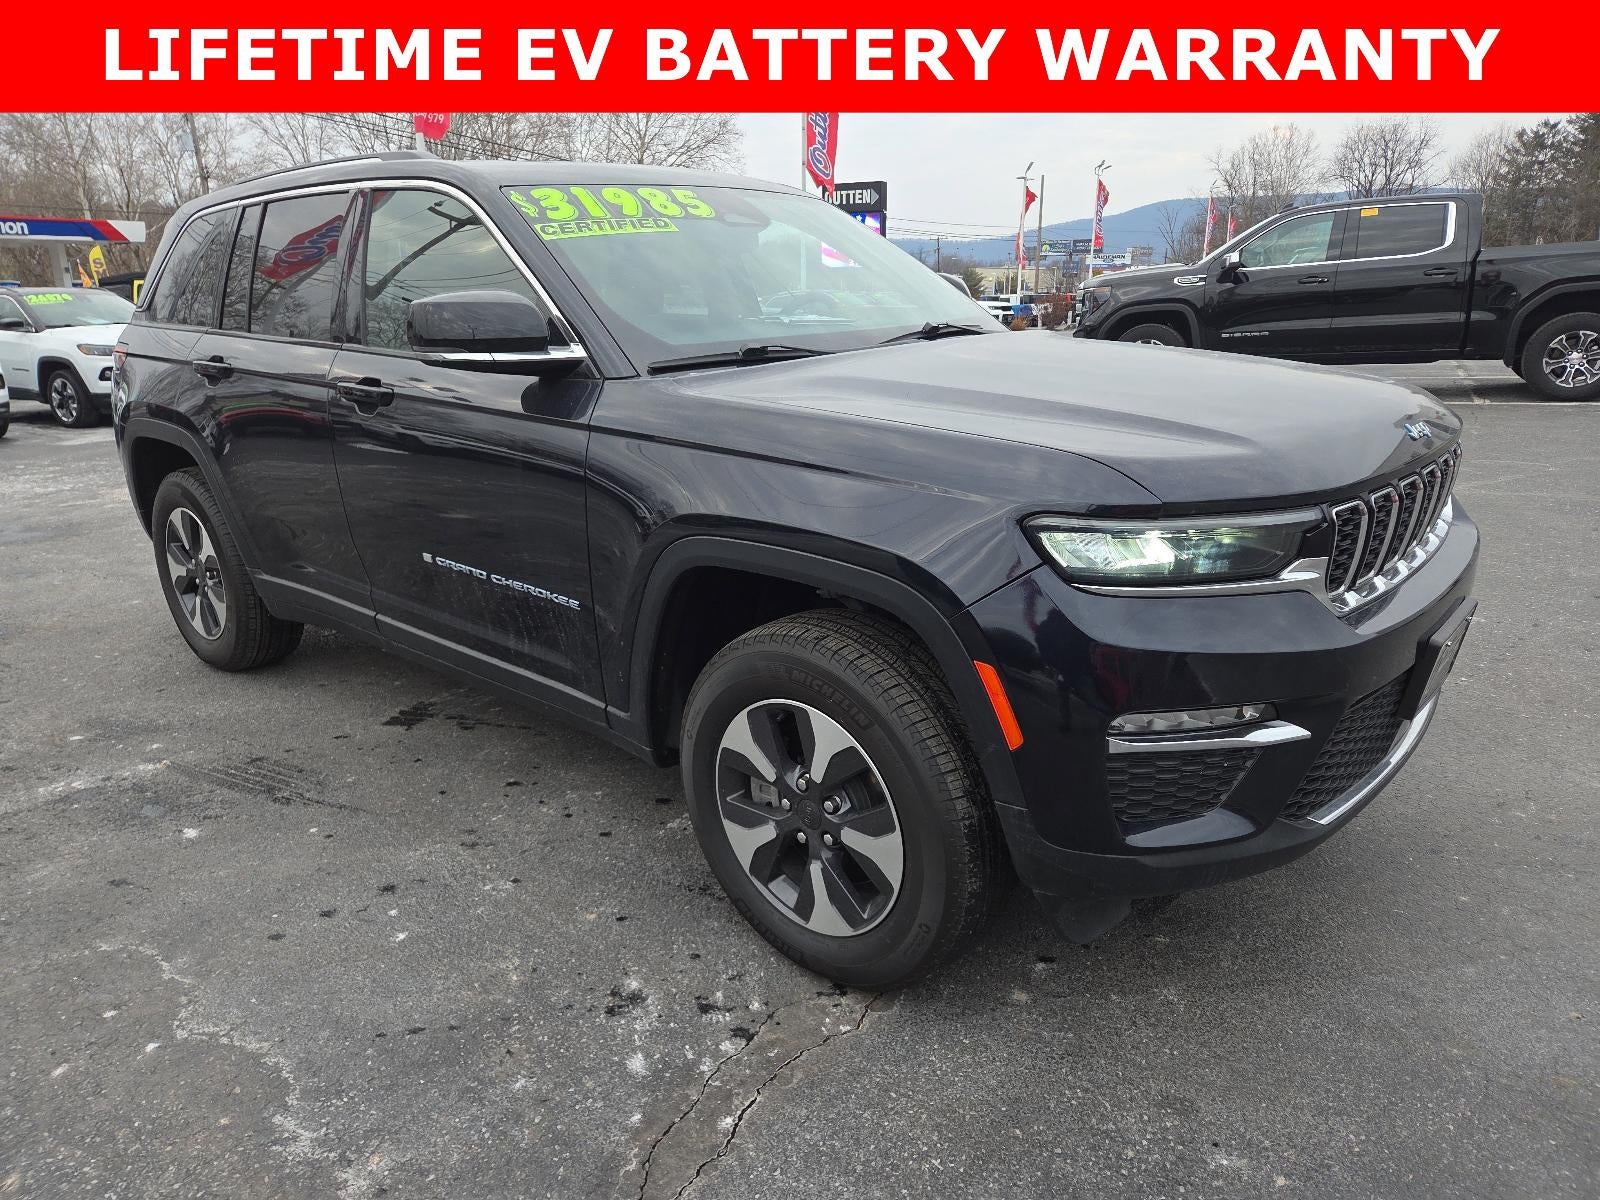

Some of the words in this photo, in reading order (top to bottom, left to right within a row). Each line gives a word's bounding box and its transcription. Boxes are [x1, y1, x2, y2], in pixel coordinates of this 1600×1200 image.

[509, 186, 716, 220] $31985
[539, 218, 671, 236] CERTIFIED
[435, 556, 487, 580] GRAND
[490, 574, 581, 610] CHEROKEE
